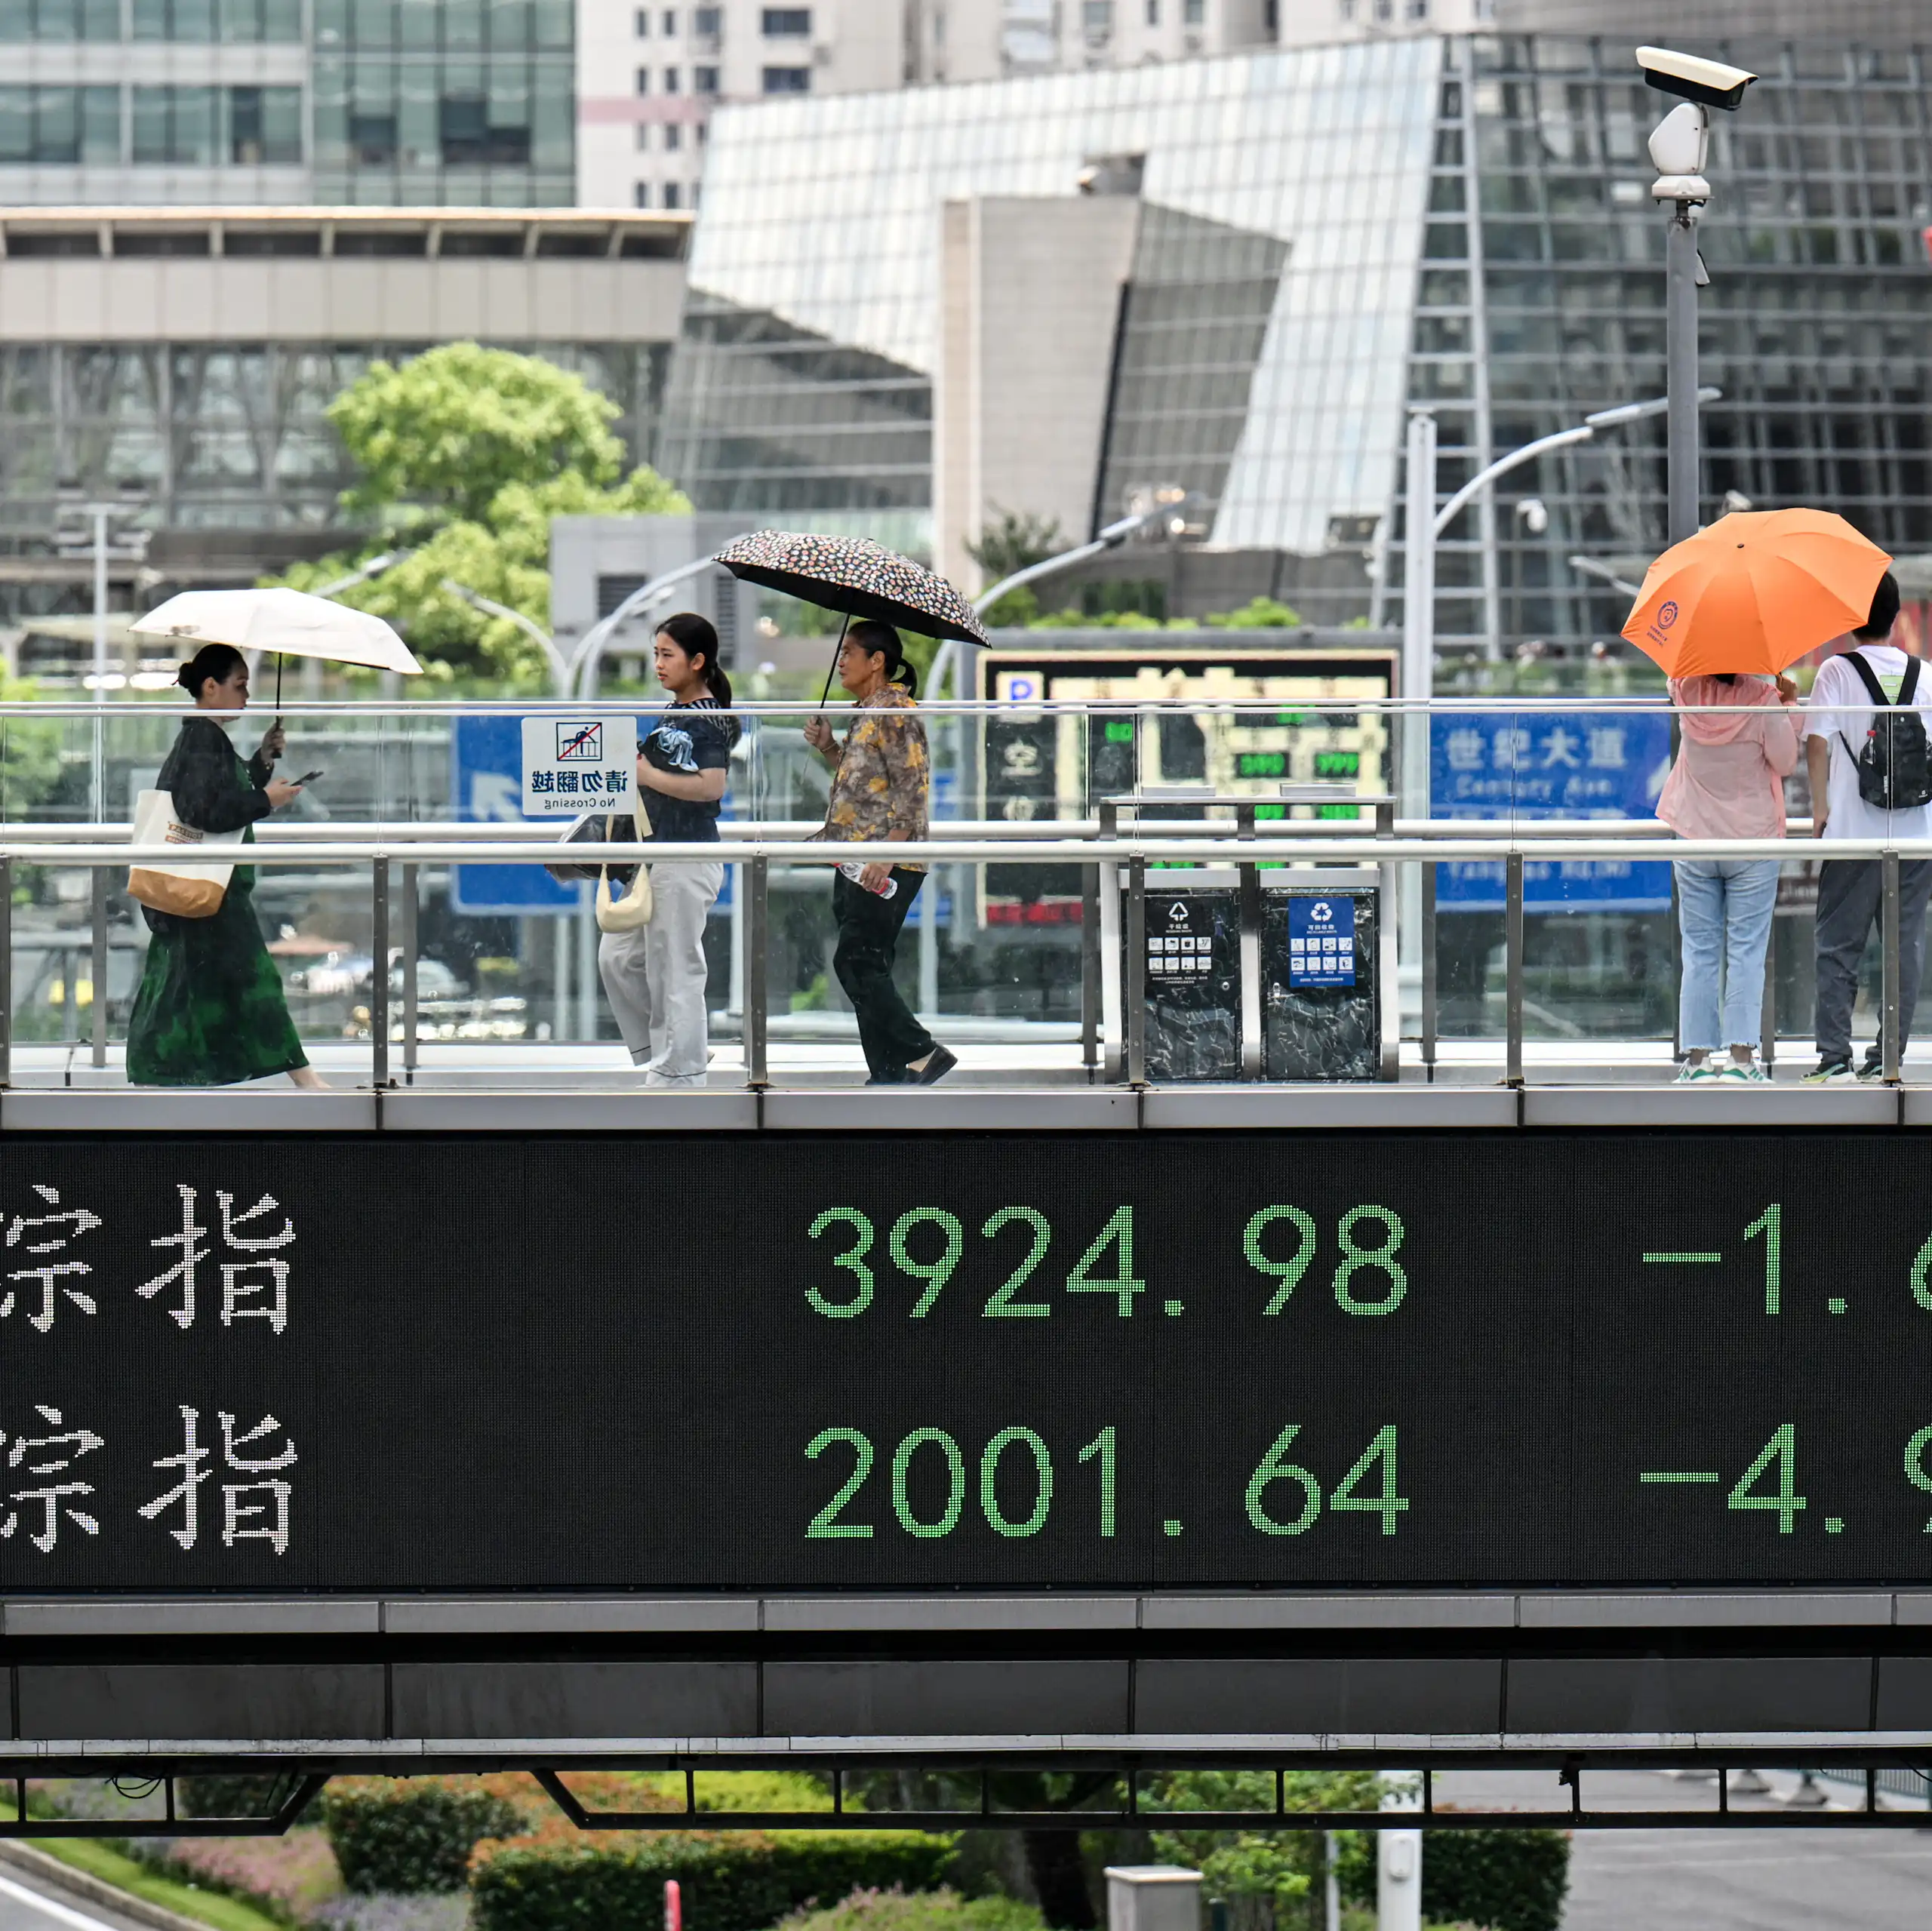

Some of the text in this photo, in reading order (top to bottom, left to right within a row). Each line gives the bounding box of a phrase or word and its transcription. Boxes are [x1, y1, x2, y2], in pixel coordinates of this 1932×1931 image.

[1447, 727, 1627, 770] 世纪大道
[804, 1205, 1407, 1318] 3924.98
[804, 1425, 1408, 1538] 2001.64
